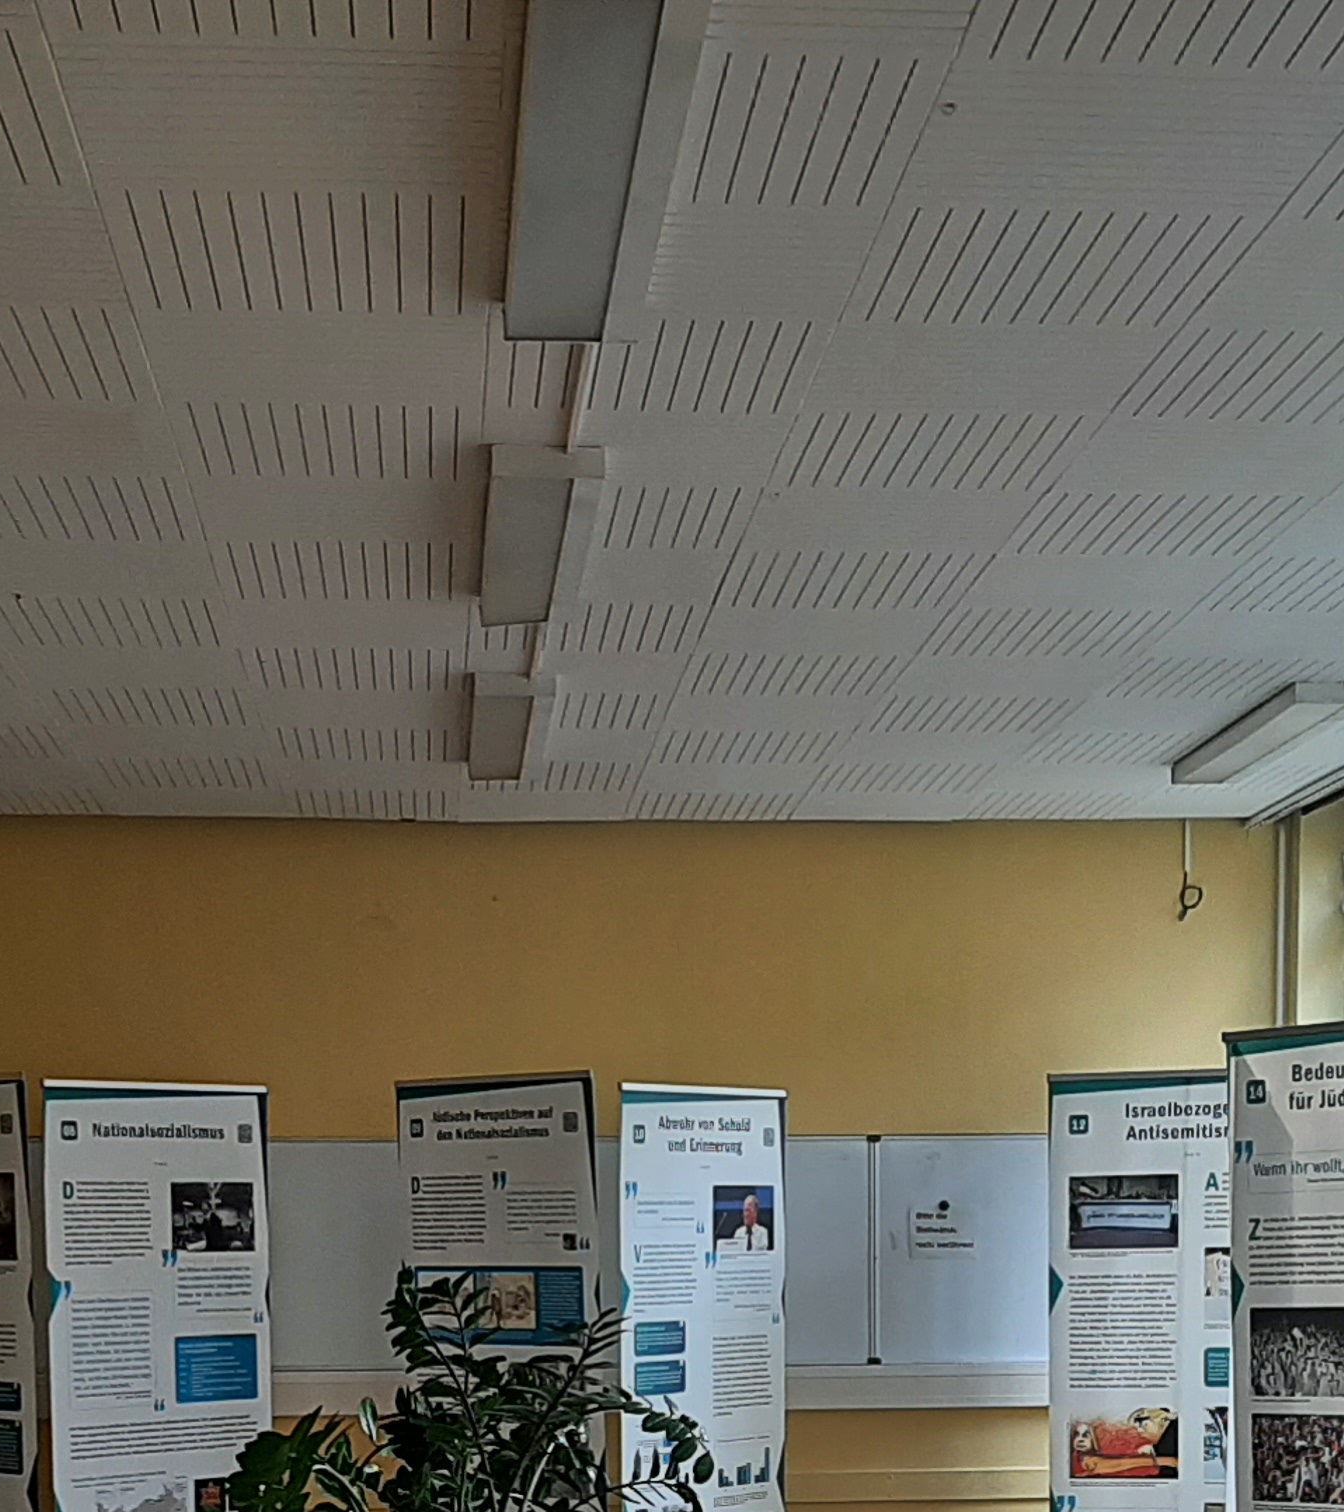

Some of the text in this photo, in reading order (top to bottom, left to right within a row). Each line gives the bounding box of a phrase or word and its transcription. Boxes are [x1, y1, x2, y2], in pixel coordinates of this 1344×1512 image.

[1248, 1085, 1263, 1099] 14
[1289, 1091, 1314, 1110] für
[92, 1122, 225, 1140] Nationalsozialismus
[62, 1180, 75, 1200] D
[411, 1176, 421, 1194] D
[1204, 1171, 1220, 1191] A
